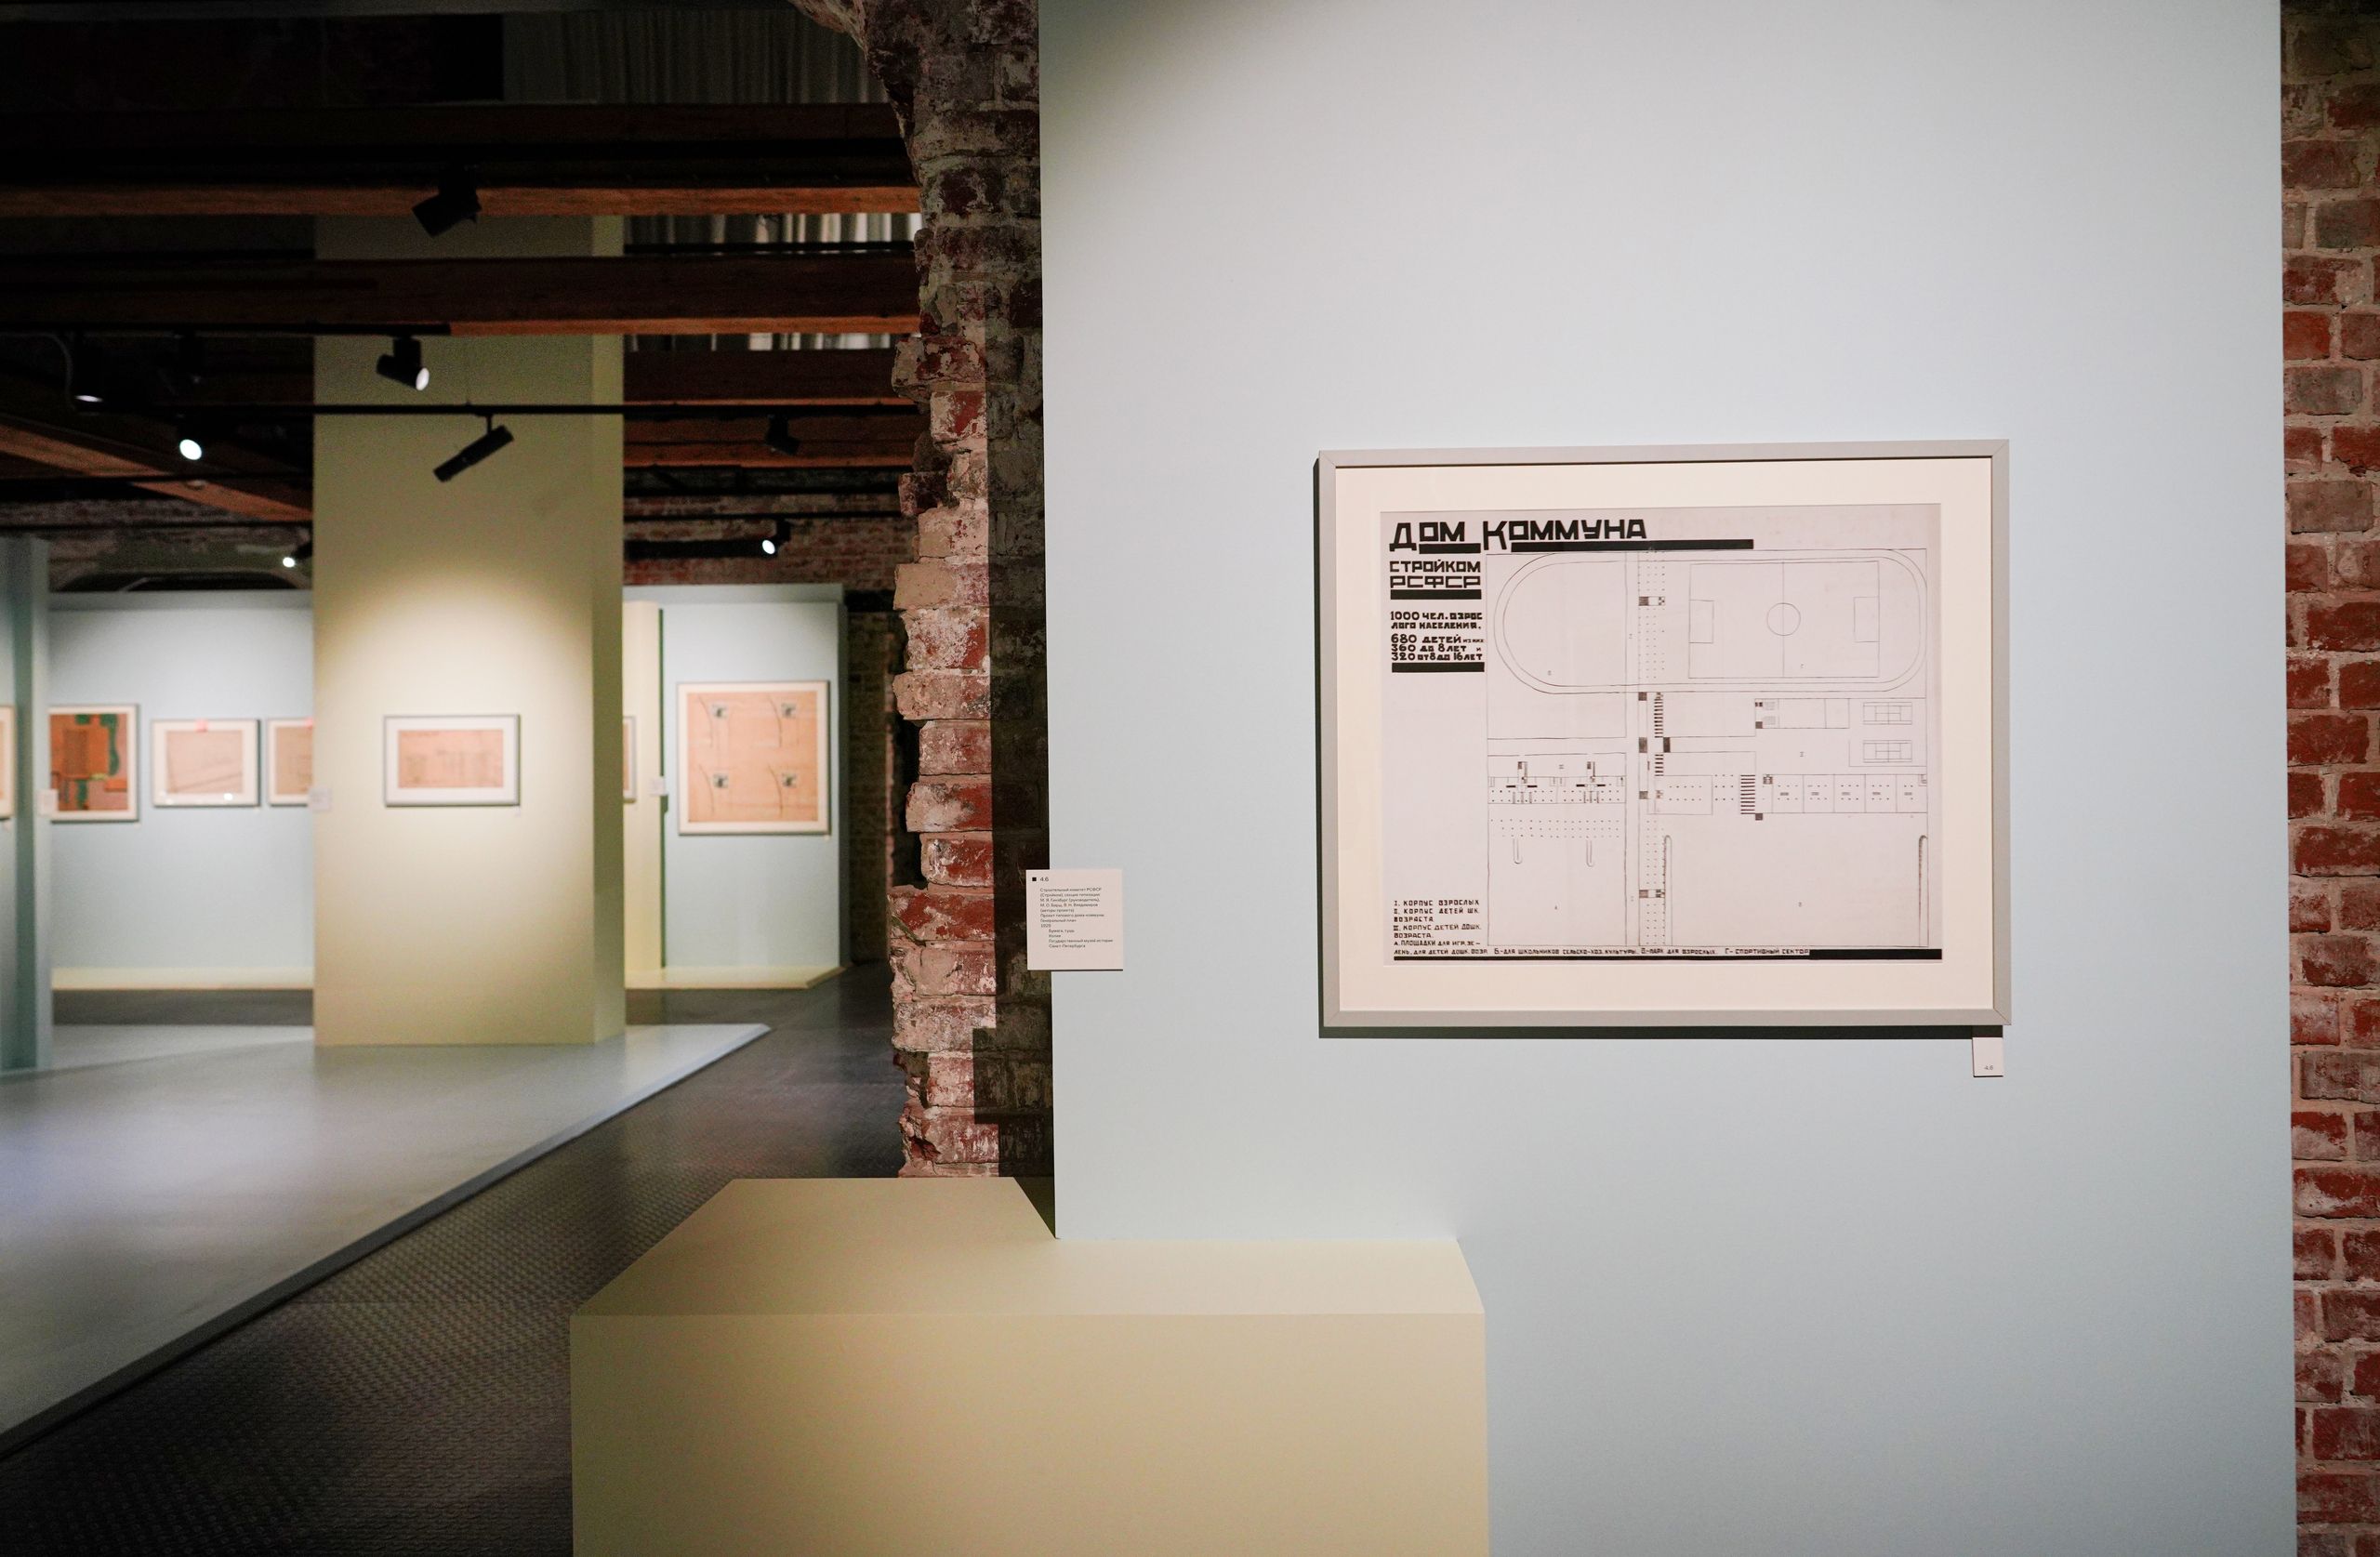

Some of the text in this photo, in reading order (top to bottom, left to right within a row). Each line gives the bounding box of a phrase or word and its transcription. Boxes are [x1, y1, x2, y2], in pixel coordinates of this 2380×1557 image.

[1390, 559, 1481, 573] СТРОЙКОМ
[1390, 575, 1481, 588] РСФСР
[1391, 611, 1420, 620] 1000
[1391, 633, 1417, 644] 680
[1422, 634, 1461, 643] ДЕТЕЙ
[1391, 643, 1416, 653] 360
[1391, 653, 1416, 661] 320
